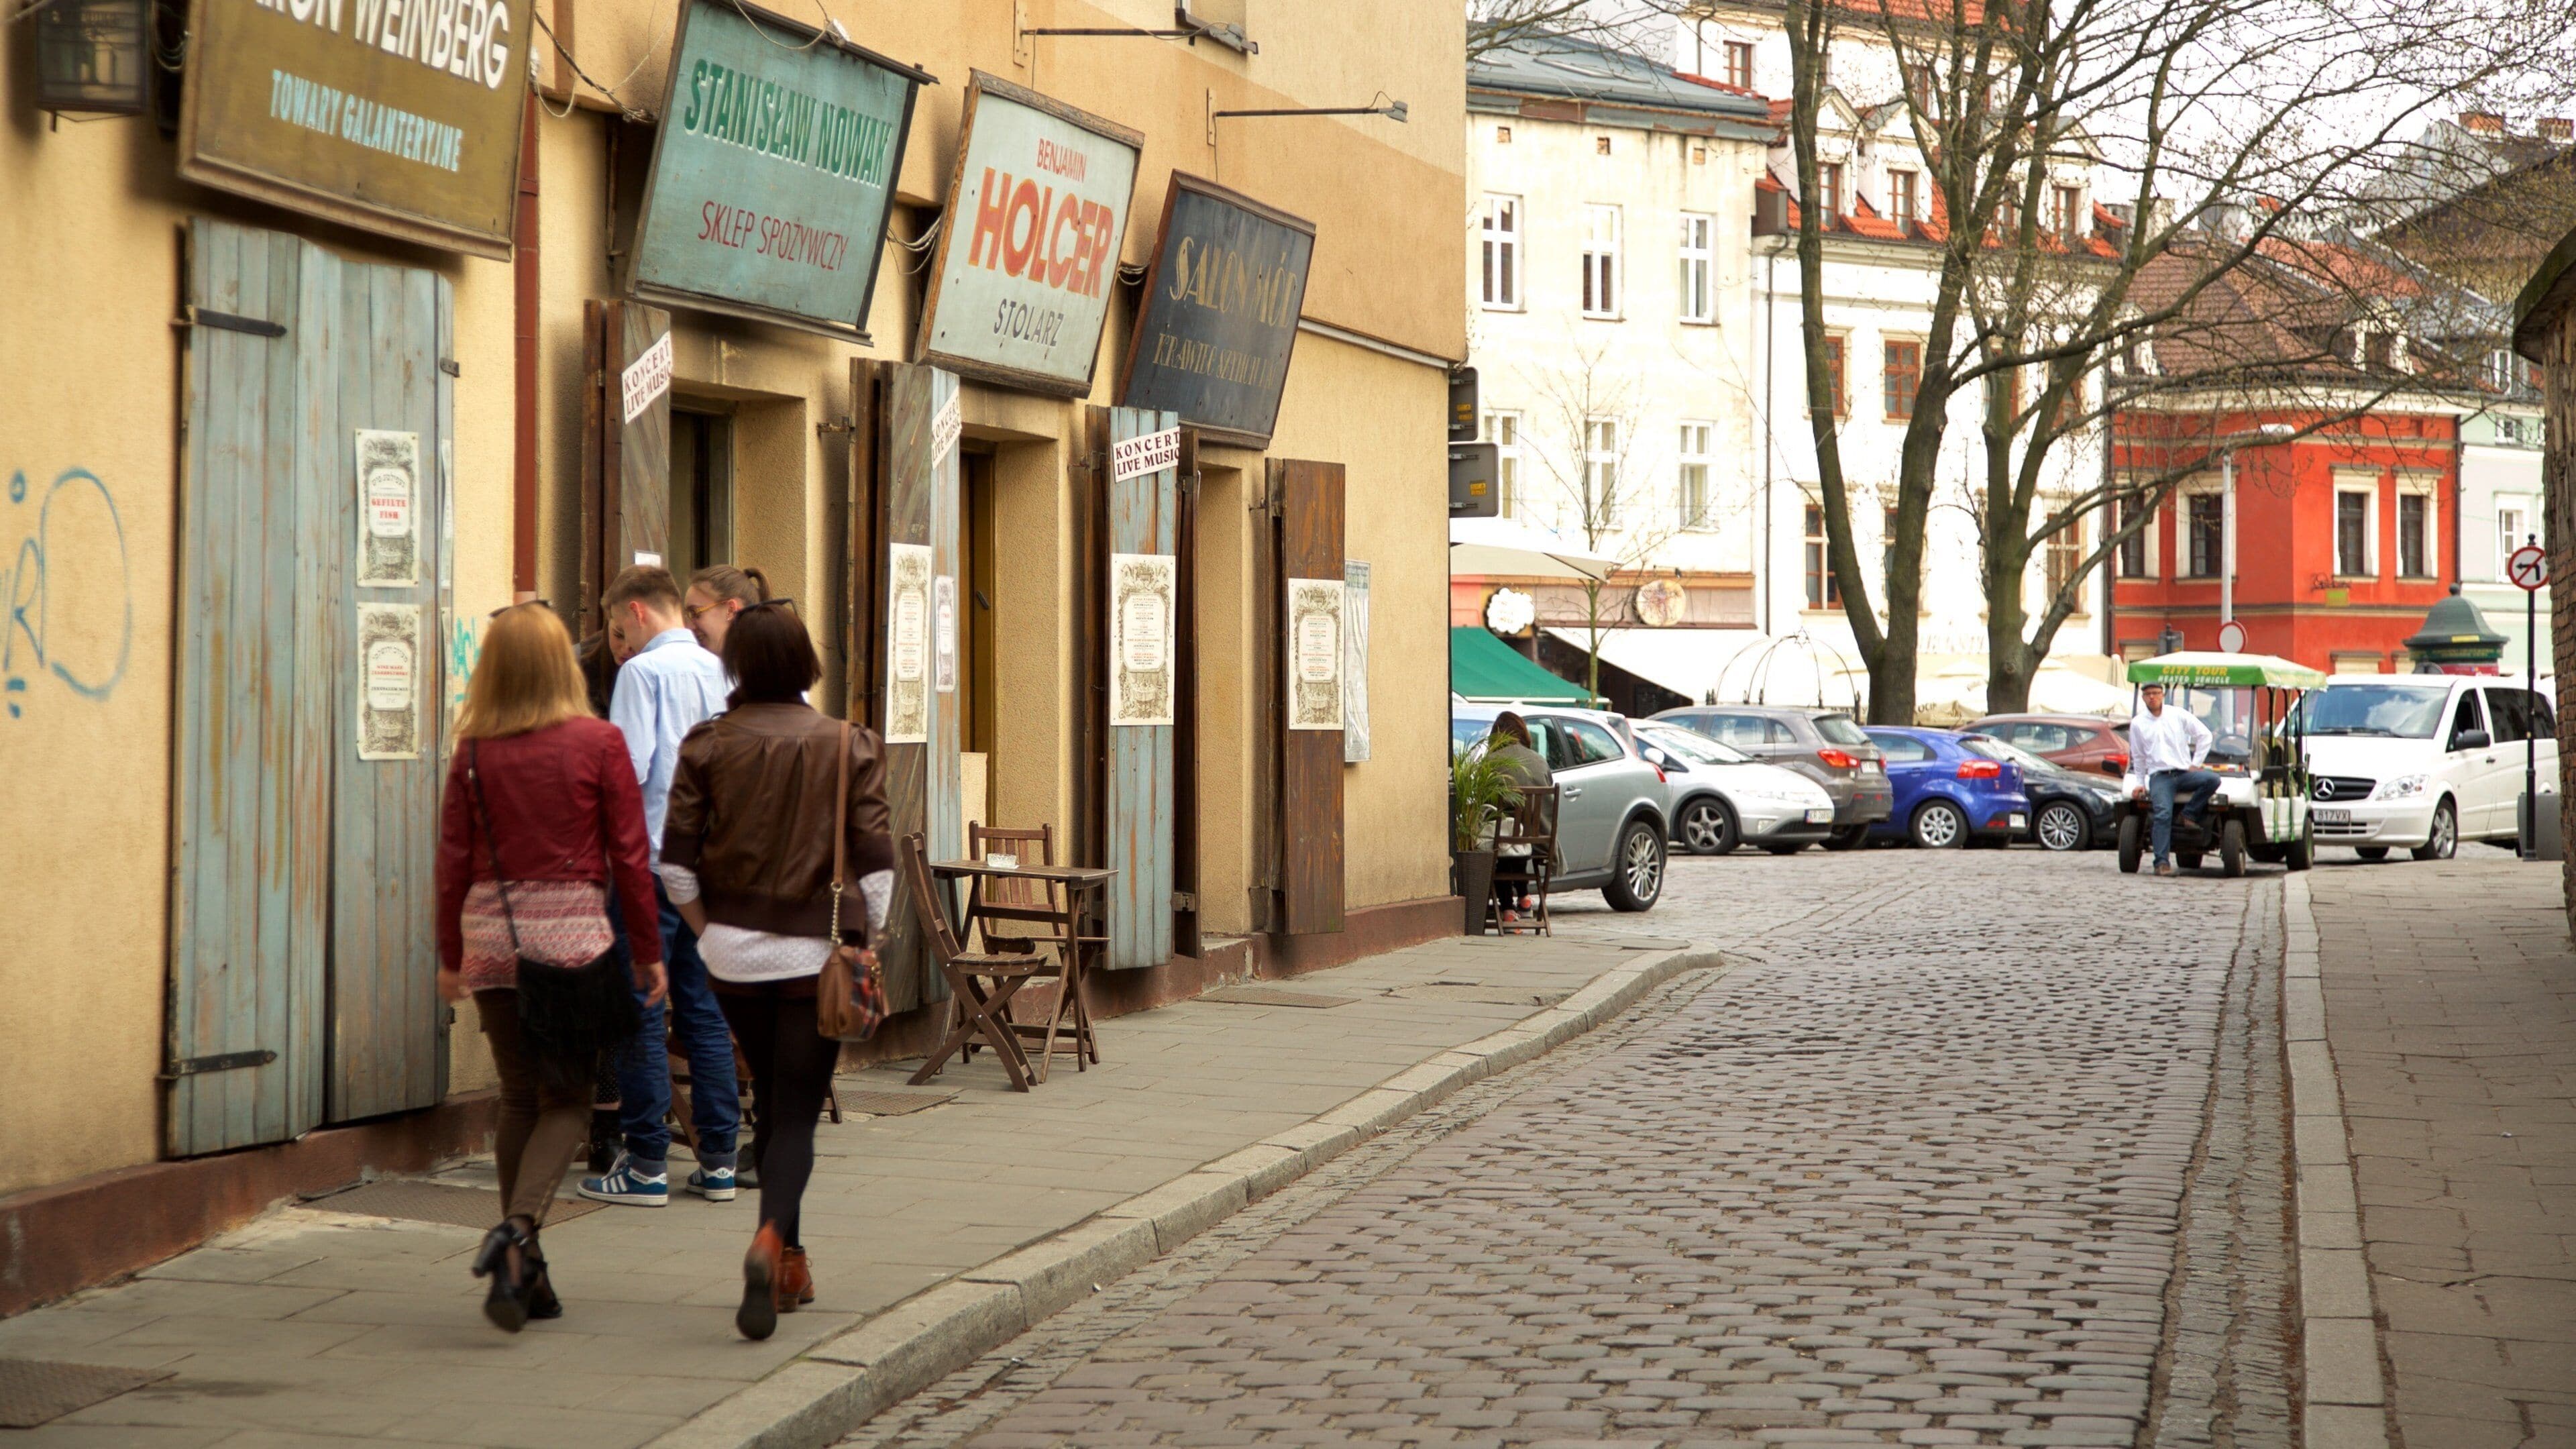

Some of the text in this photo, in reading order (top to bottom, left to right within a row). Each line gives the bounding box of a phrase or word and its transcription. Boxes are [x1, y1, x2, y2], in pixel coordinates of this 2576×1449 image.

[355, 0, 509, 89] WEINBERG
[271, 69, 463, 172] TOWARY GALANTERYJNE
[684, 58, 892, 189] STANISŁAW NOWAK
[1036, 138, 1087, 183] BENJAMIN
[698, 201, 849, 271] SKLEP SPOŻYWCZY
[968, 166, 1114, 299] HOLCER
[1169, 236, 1298, 327] SALON MÓD
[994, 299, 1064, 347] STOLARZ
[624, 341, 669, 394] KONCERT
[1152, 333, 1218, 376] KRAWIEC
[626, 361, 672, 414] LIVE MUSIC
[1116, 431, 1180, 460] KONCERT
[1117, 447, 1179, 476] LIVE MUSIC
[372, 498, 407, 507] GEFILTE
[2157, 675, 2231, 684] HEATED VEHICLE
[2162, 665, 2227, 676] CITY TOUR
